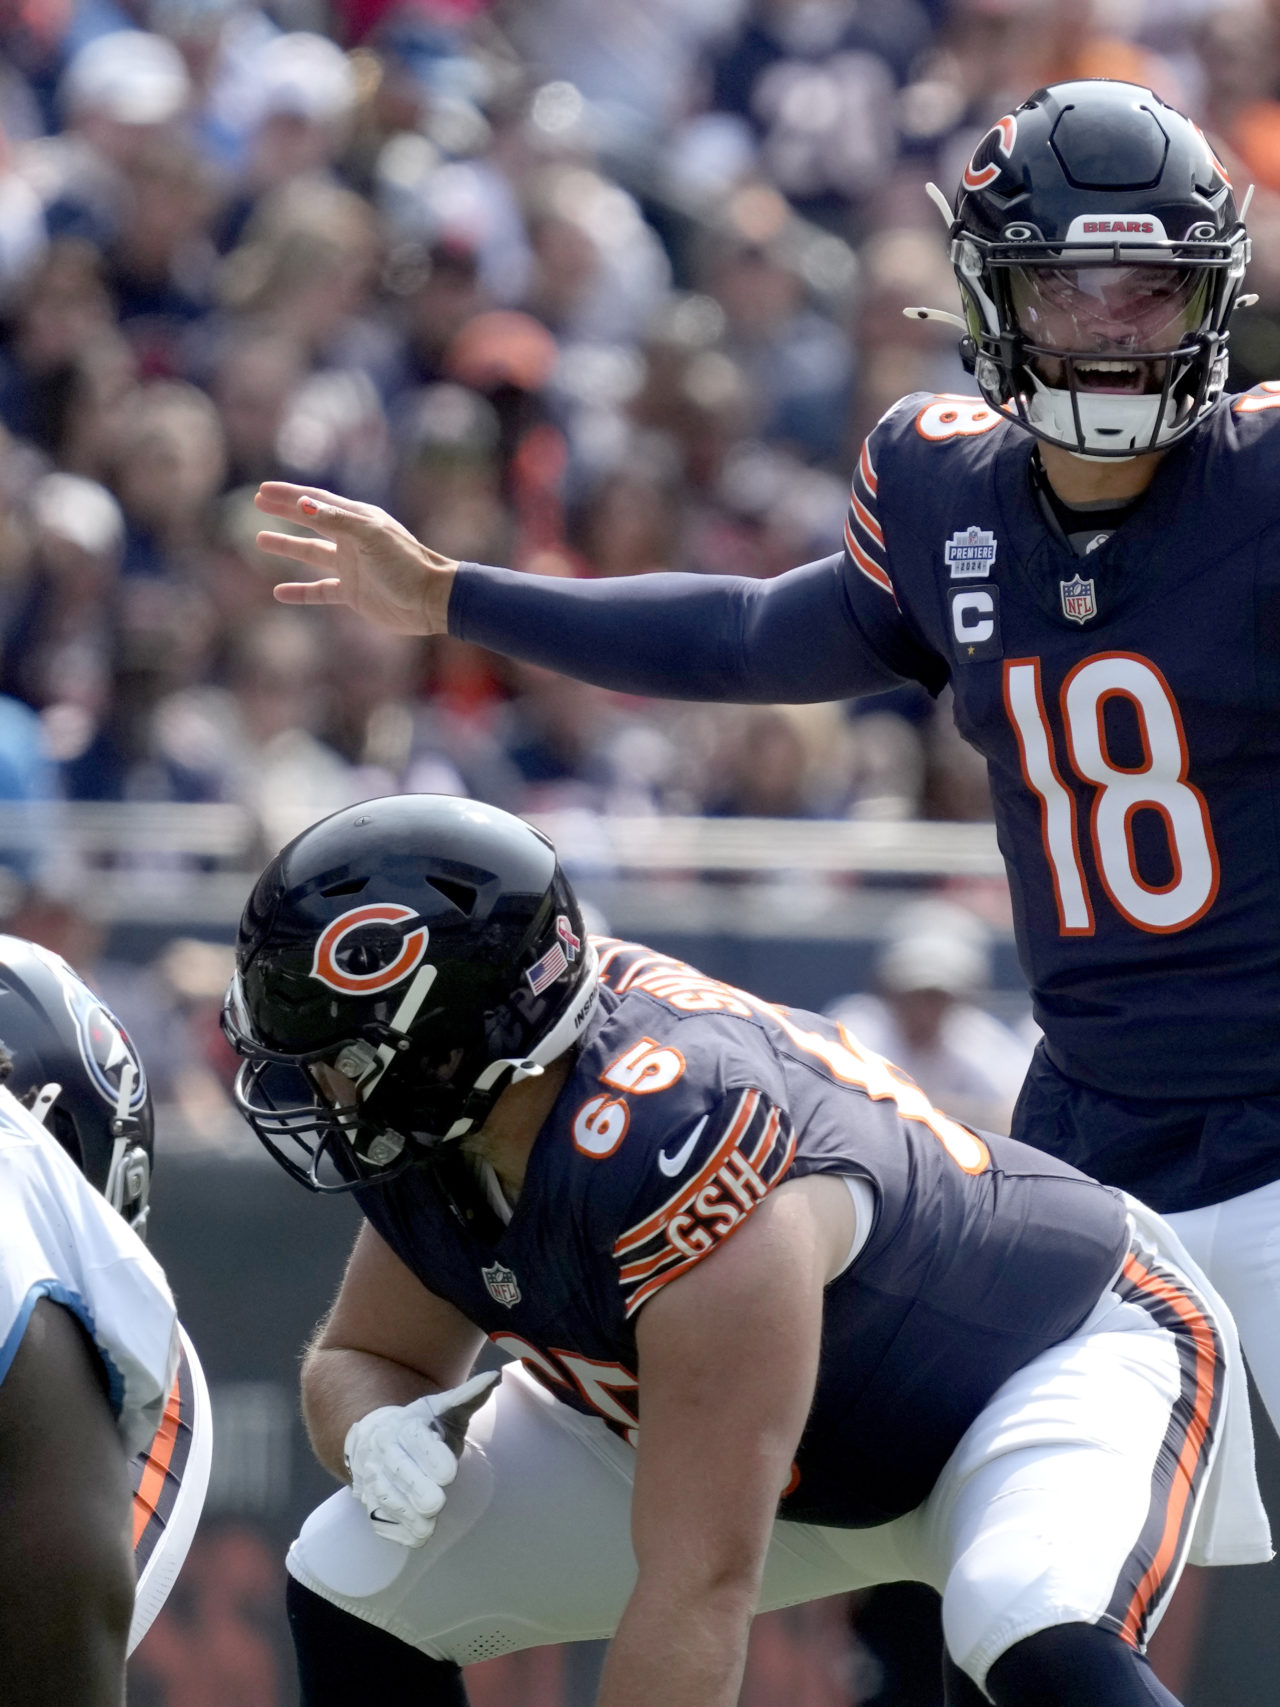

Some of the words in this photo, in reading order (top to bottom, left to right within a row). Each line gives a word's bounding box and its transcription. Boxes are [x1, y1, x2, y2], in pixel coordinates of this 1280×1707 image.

[1083, 221, 1154, 234] BEARS
[960, 561, 982, 571] 2024
[952, 591, 994, 643] C
[1067, 597, 1091, 615] NFL
[1003, 650, 1220, 936] 18
[571, 1036, 687, 1160] 65
[665, 1149, 770, 1260] GSH
[491, 1284, 516, 1300] NFL
